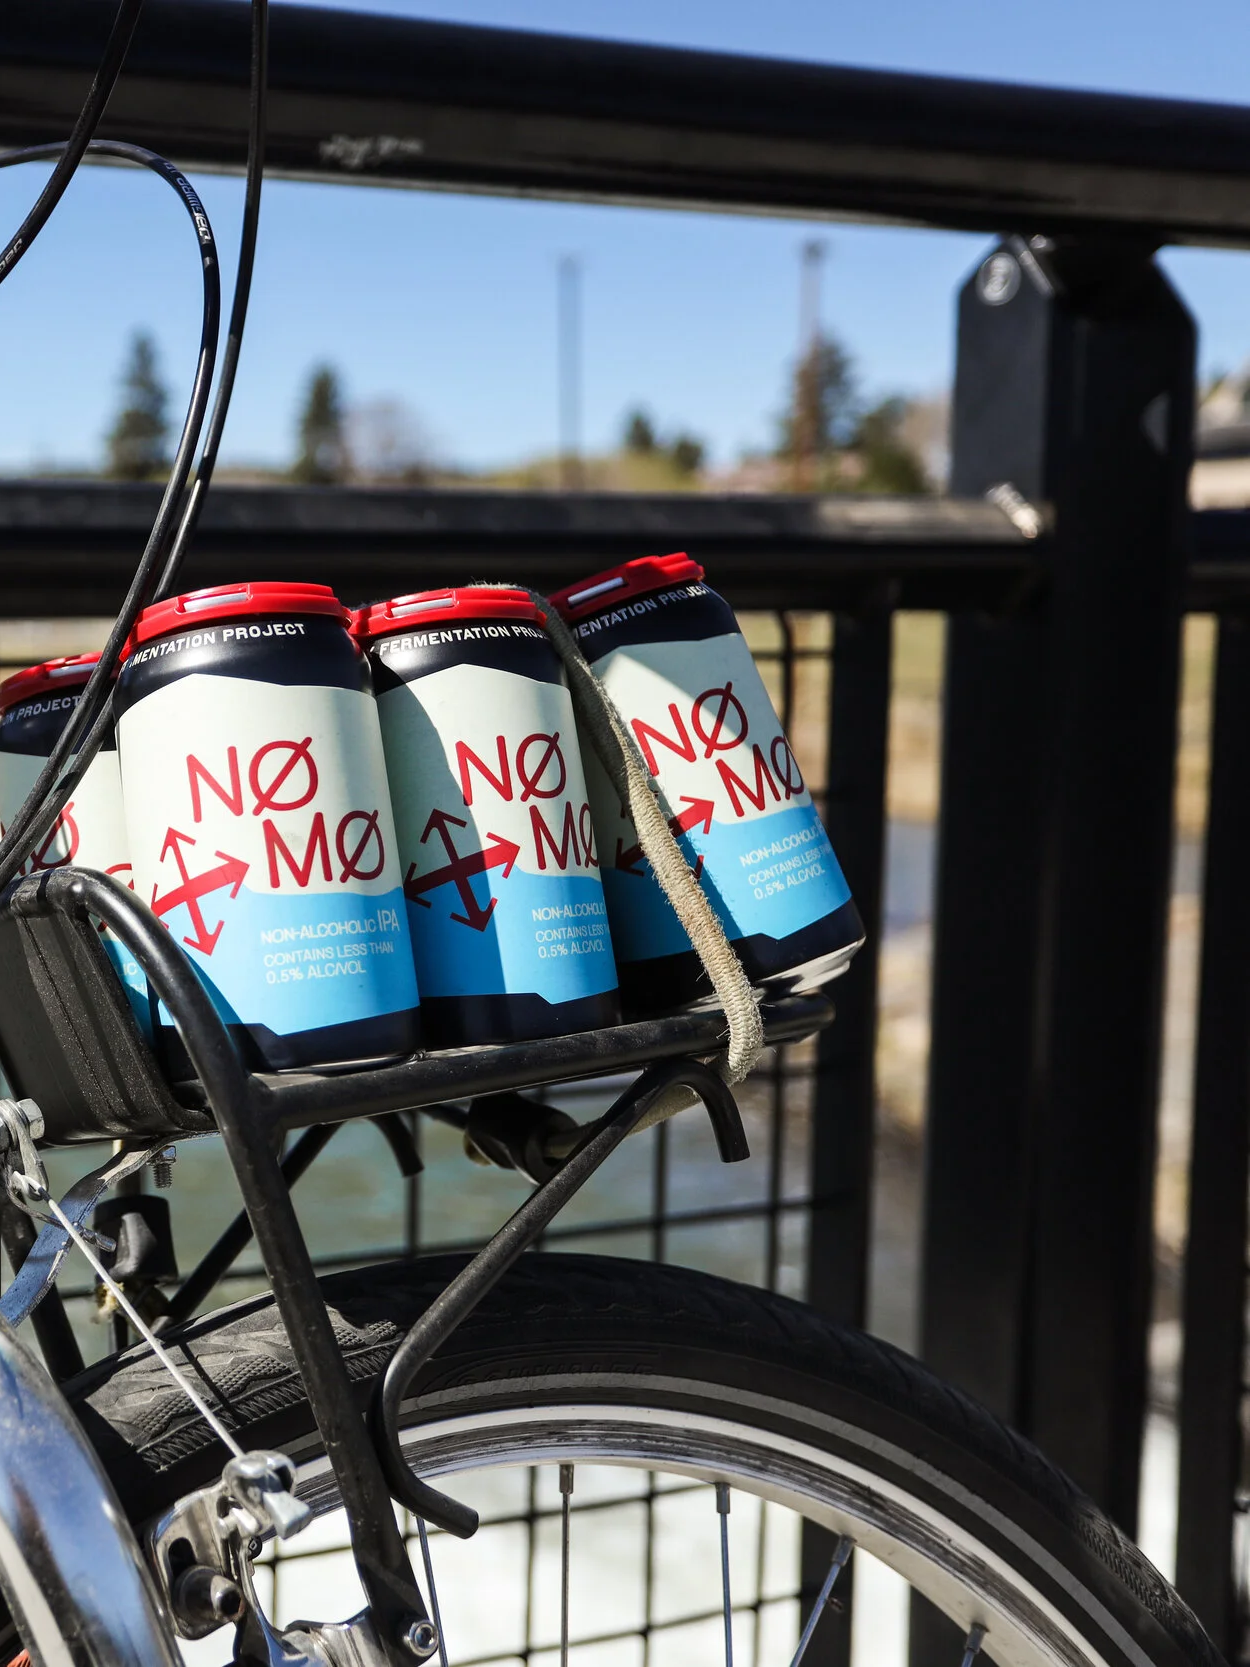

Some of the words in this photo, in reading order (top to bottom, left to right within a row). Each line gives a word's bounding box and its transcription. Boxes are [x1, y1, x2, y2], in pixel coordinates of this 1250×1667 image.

[575, 598, 658, 640] ENTATION
[122, 631, 216, 672] MENTATION
[222, 623, 306, 643] PROJECT
[379, 625, 511, 656] FERMENTATION
[16, 695, 84, 720] PROJECT
[630, 681, 749, 777] NØ
[186, 736, 319, 823] NØ
[455, 731, 567, 807] NØ
[715, 735, 805, 818] MØ
[262, 809, 385, 888] MØ
[748, 856, 803, 886] CONTAINS
[260, 918, 377, 946] NON-ALCOHOLIC
[377, 908, 400, 932] IPA
[535, 926, 588, 943] CONTAINS
[264, 946, 334, 968] CONTAINS
[336, 943, 367, 958] LESS
[369, 941, 395, 955] THAN
[538, 943, 568, 959] 0.5%
[265, 966, 304, 985] 0.5%
[307, 960, 367, 979] ALC/VOL
